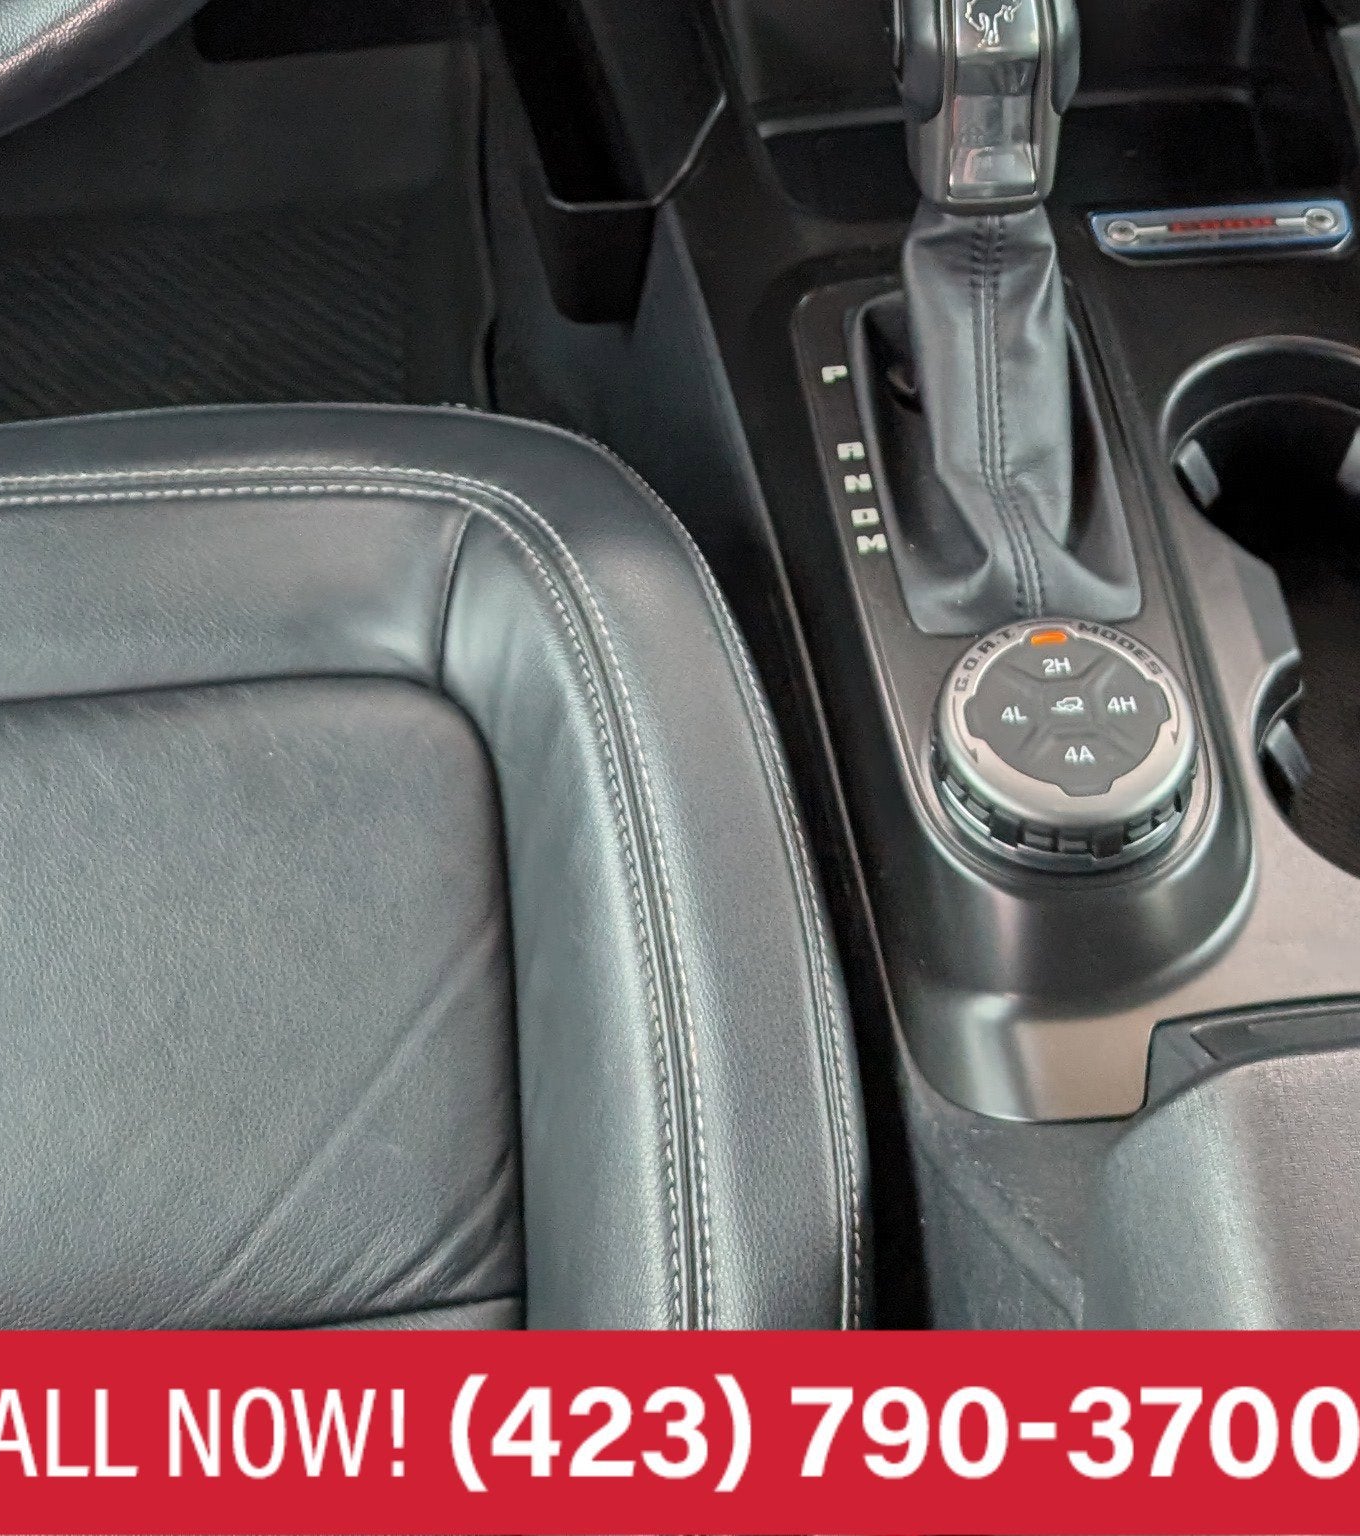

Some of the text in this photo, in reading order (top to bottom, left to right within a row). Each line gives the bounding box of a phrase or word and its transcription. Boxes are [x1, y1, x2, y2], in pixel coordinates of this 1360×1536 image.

[822, 365, 848, 383] P
[837, 441, 865, 460] R
[844, 473, 872, 493] N
[851, 507, 880, 527] D
[856, 533, 888, 554] M
[1078, 622, 1163, 675] MODES
[1042, 657, 1071, 675] 2H
[1107, 695, 1137, 713] 4H
[1001, 706, 1028, 724] 4L
[1064, 745, 1096, 763] 4A
